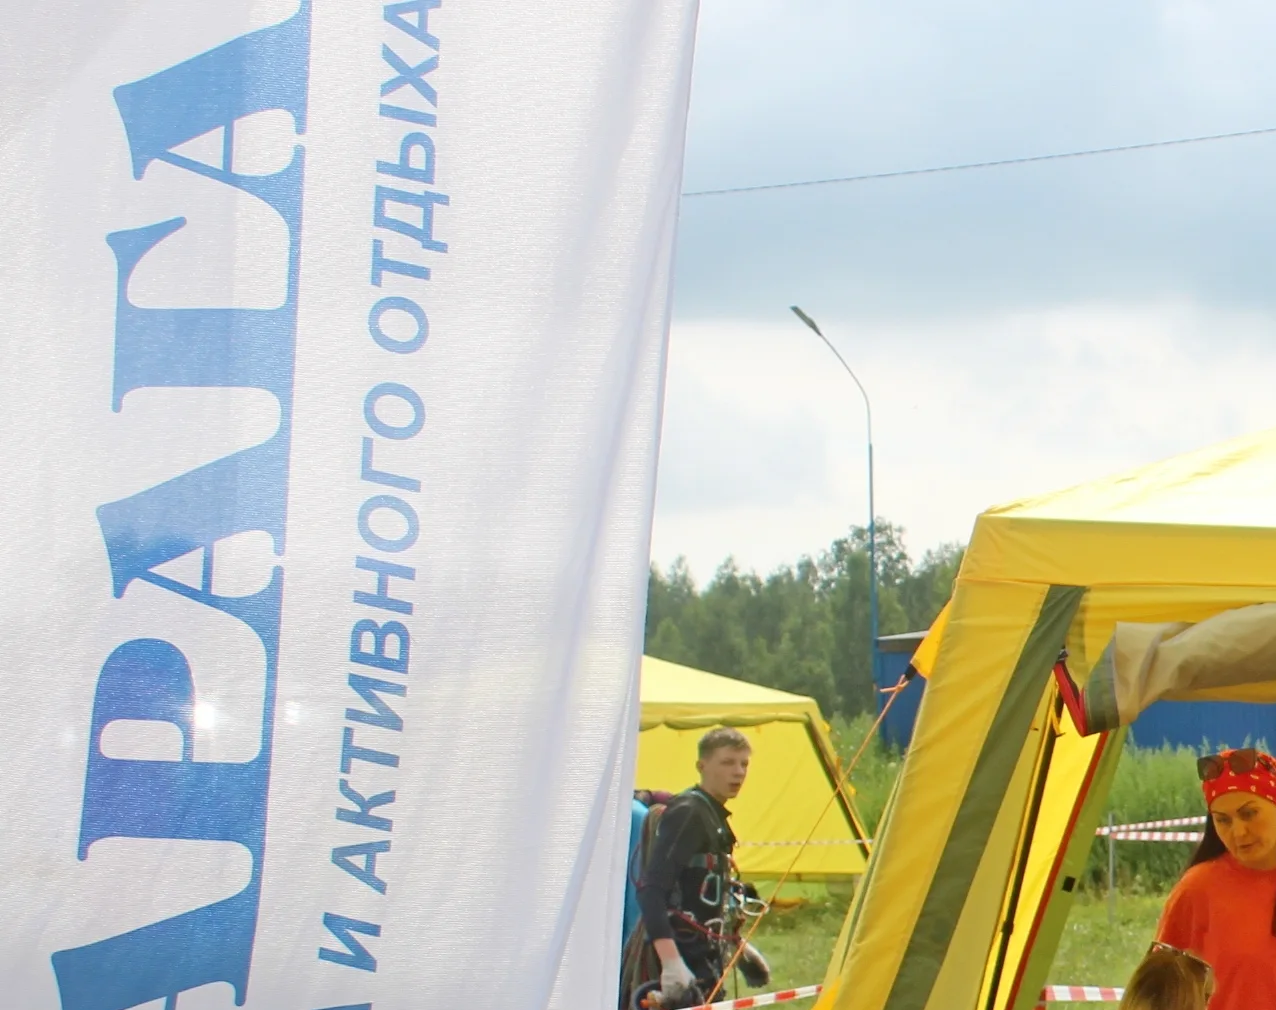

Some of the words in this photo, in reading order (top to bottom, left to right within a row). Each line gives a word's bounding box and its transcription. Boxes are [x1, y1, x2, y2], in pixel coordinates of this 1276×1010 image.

[368, 0, 450, 353] ОТДЫХА
[331, 383, 426, 894] АКТИВНОГО
[317, 912, 381, 972] И
